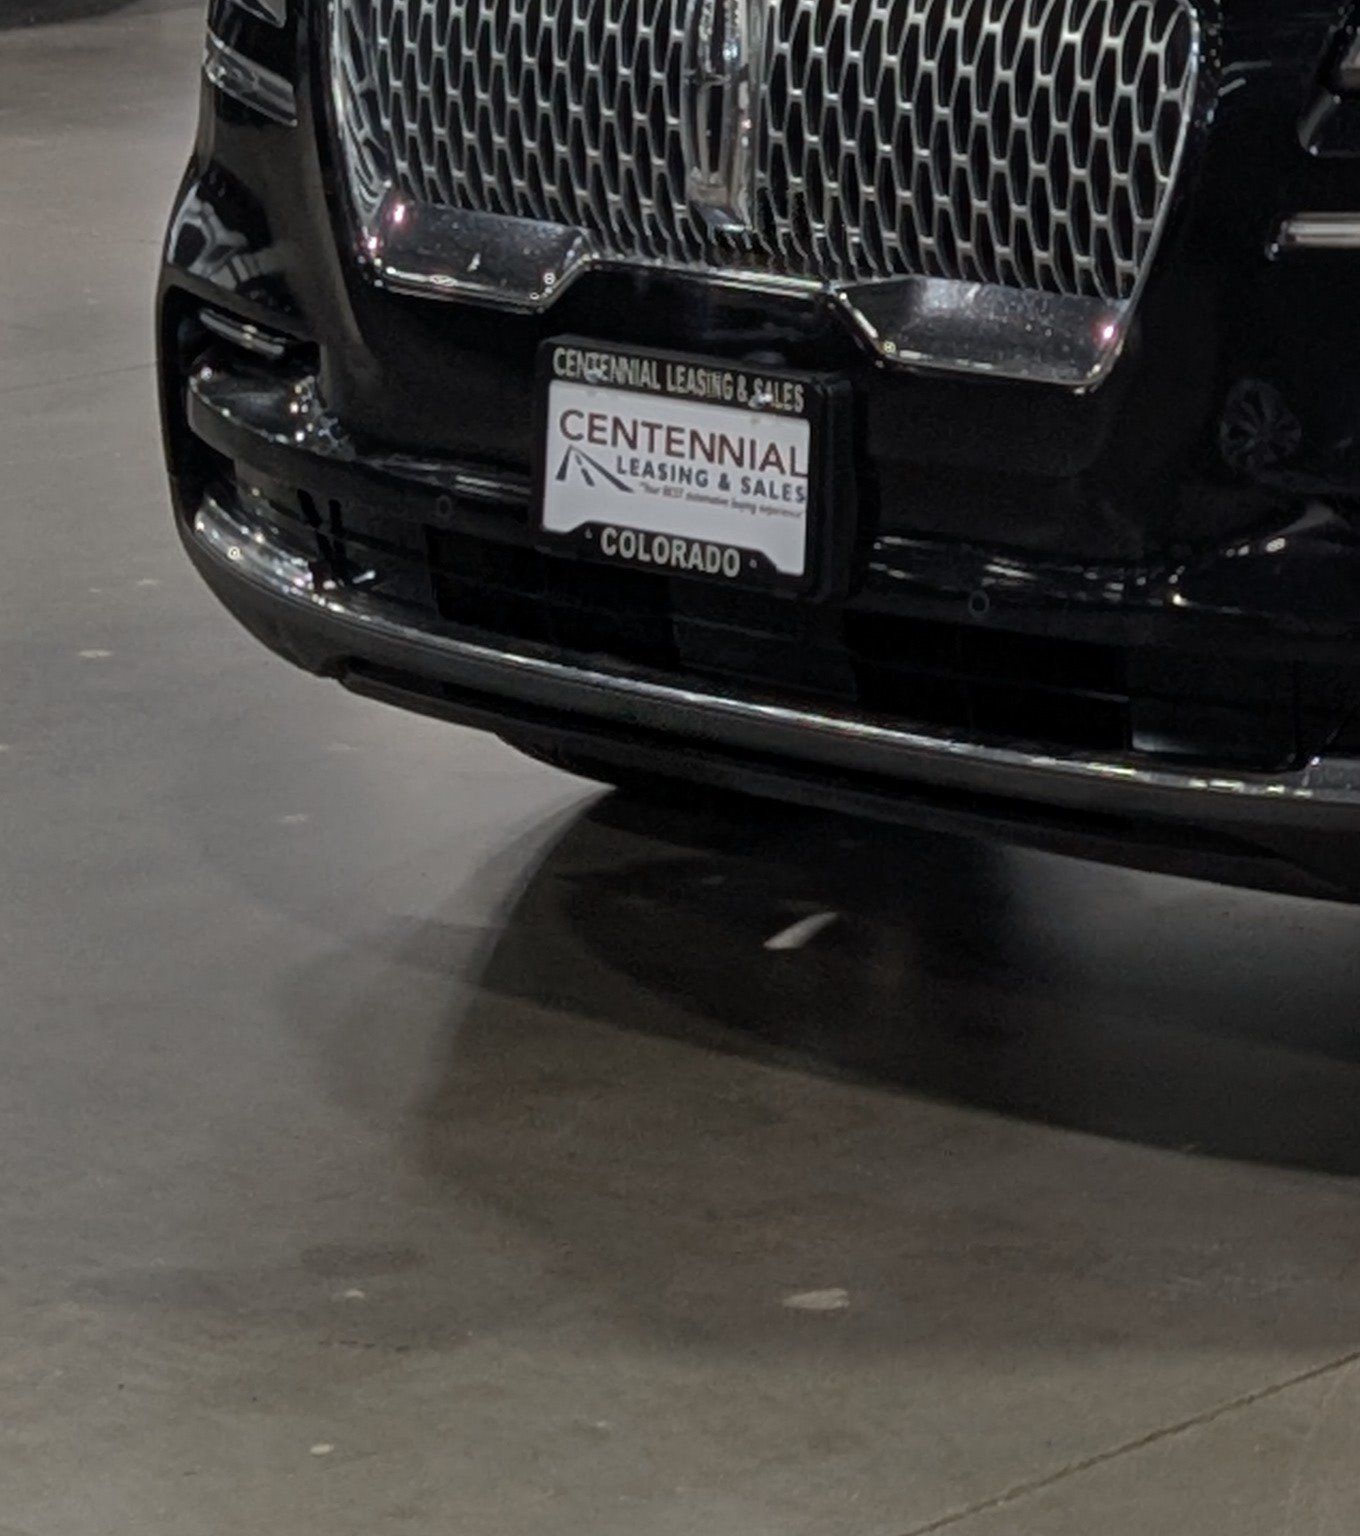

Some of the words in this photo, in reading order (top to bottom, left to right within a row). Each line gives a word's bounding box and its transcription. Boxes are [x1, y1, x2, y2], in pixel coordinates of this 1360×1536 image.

[552, 347, 662, 393] CENTENNIAL
[666, 365, 734, 403] LEASING
[736, 380, 748, 404] &
[750, 379, 805, 413] SALES
[558, 408, 809, 479] CENTENNIAL
[616, 455, 709, 488] LEASING
[718, 472, 731, 492] &
[741, 475, 806, 504] SALES
[599, 526, 741, 579] COLORADO
